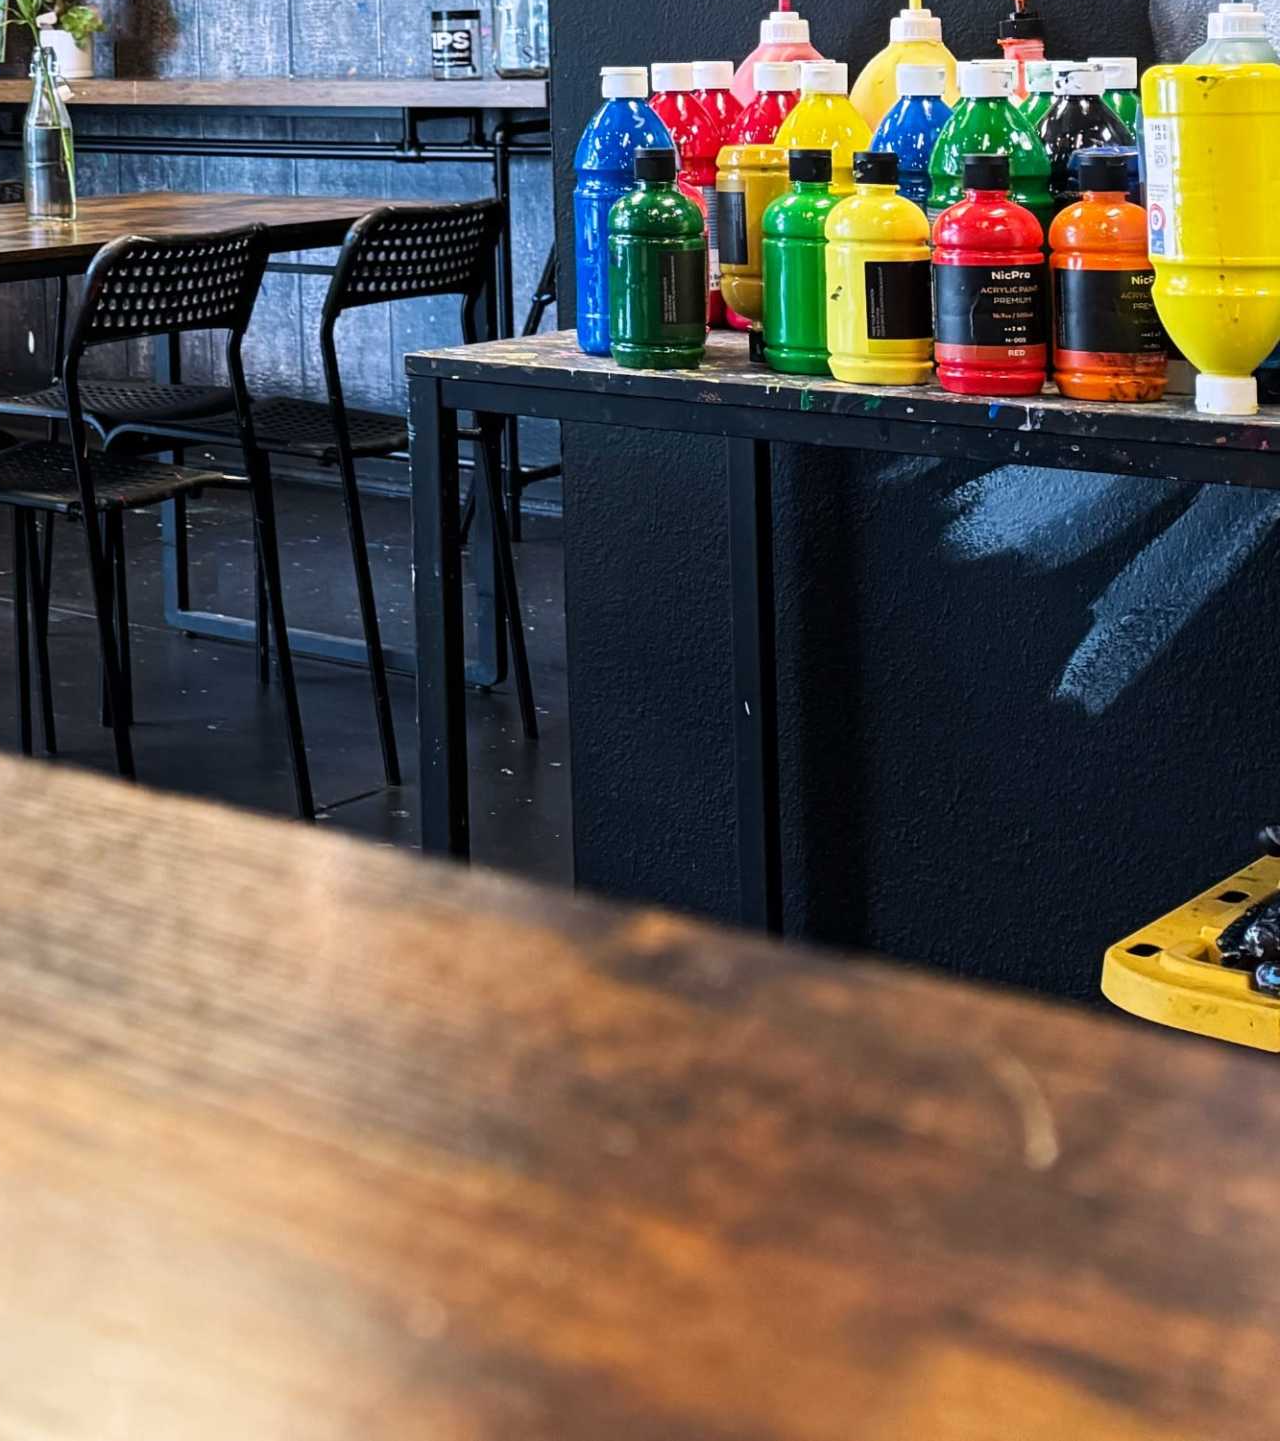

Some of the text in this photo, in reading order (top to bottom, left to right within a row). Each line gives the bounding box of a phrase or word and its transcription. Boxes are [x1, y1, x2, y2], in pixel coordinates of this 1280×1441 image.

[431, 31, 470, 50] IPS
[991, 270, 1031, 280] NicPro
[993, 296, 1032, 305] PREMIUM
[1007, 349, 1026, 357] RED
